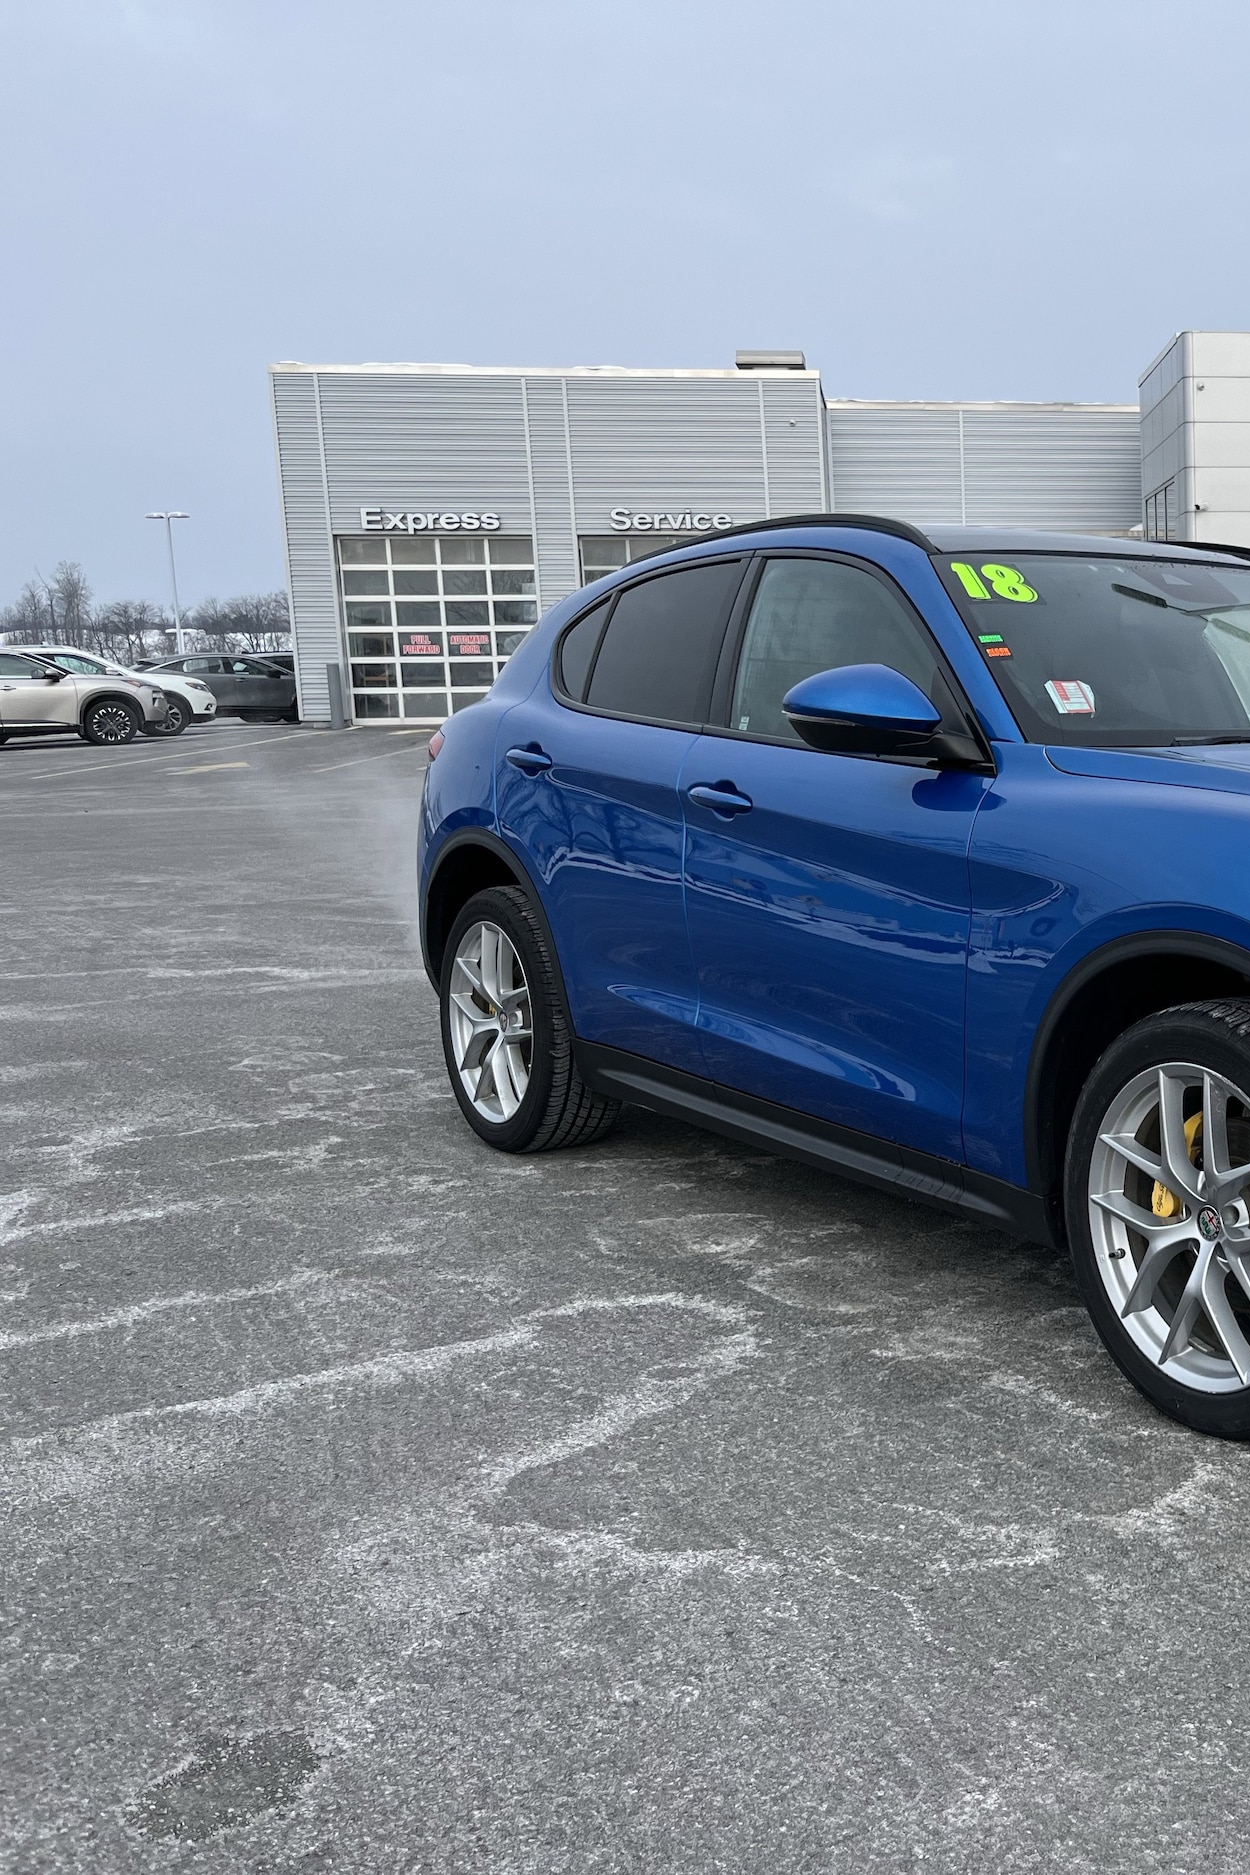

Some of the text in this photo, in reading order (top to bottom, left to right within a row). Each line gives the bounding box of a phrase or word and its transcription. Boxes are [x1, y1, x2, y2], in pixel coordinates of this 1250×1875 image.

[360, 507, 500, 535] Express
[610, 508, 732, 530] Service
[951, 562, 1038, 602] 18
[411, 635, 431, 645] PULL
[450, 635, 489, 645] AUTOMATIC
[403, 645, 440, 654] FORWARD
[460, 645, 480, 654] DOOR
